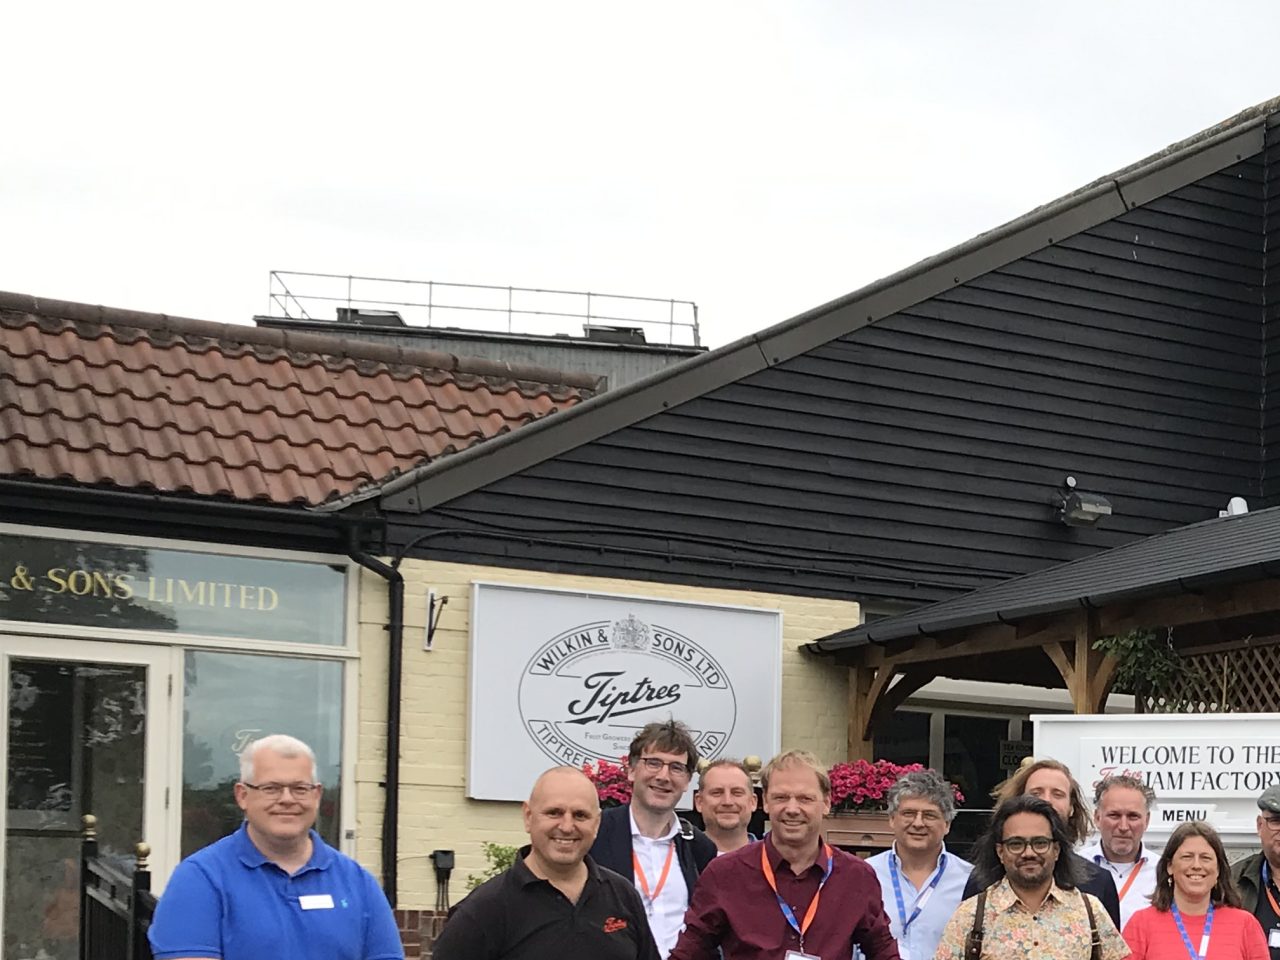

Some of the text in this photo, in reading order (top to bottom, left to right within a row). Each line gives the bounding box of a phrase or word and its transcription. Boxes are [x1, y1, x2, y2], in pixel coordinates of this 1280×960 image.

[10, 565, 279, 611] & SONS LIMITED
[536, 631, 594, 672] WILKIN
[597, 628, 609, 643] &
[652, 633, 696, 662] SONS
[695, 657, 721, 686] LTD
[566, 670, 682, 725] Tiptree
[1101, 745, 1201, 766] WELCOME
[1206, 745, 1235, 765] TO
[1144, 770, 1184, 791] JAM
[1161, 809, 1208, 822] MENU
